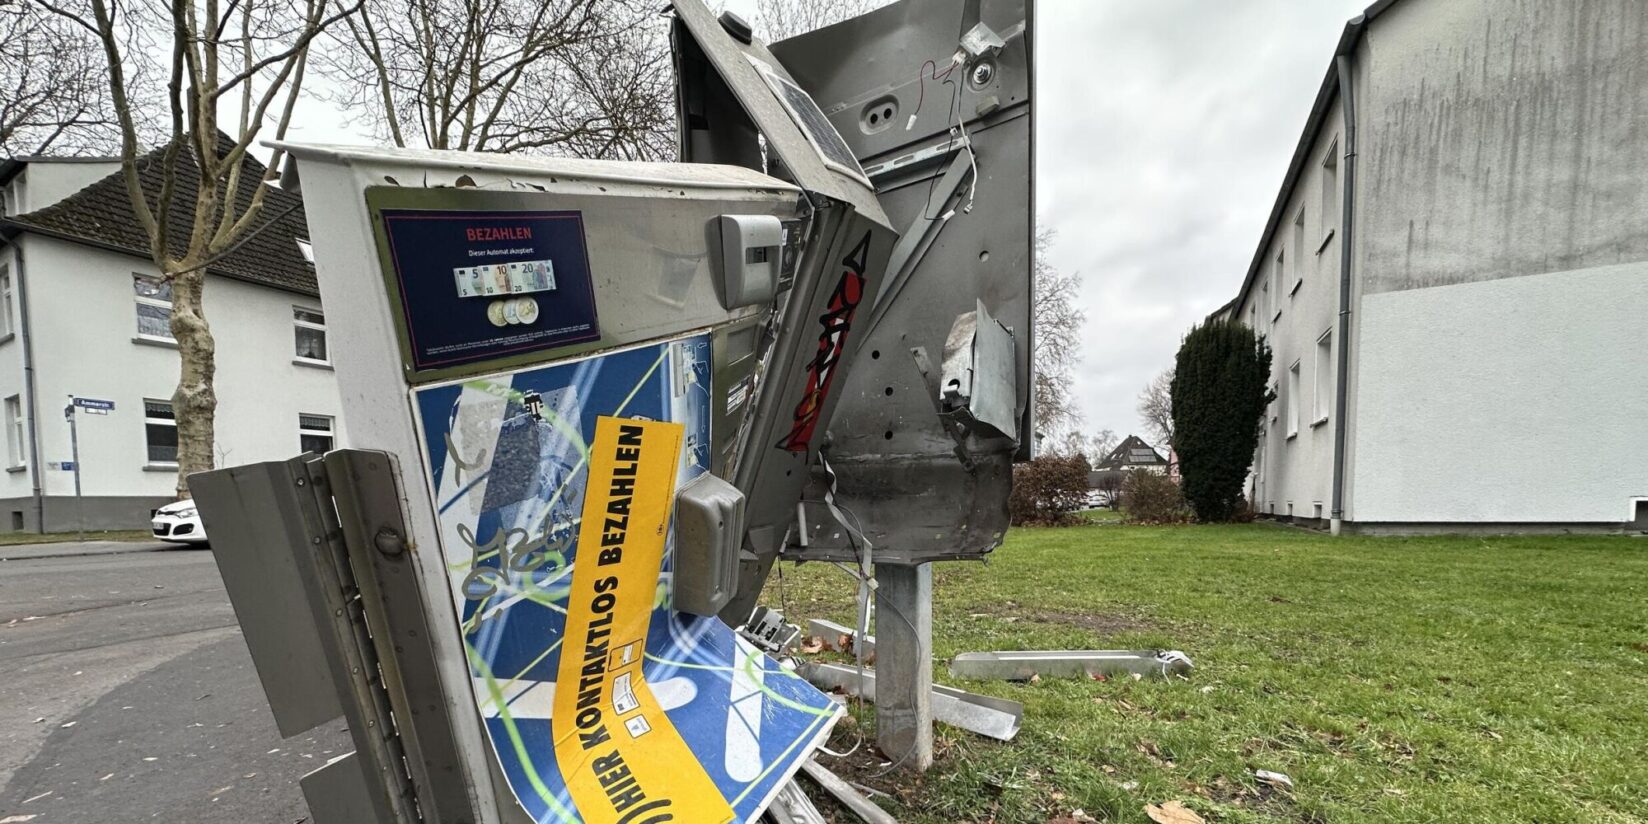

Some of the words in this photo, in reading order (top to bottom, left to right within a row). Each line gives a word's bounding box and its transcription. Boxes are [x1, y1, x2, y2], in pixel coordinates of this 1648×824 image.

[466, 227, 532, 241] BEZAHLEN
[487, 248, 509, 256] Automat
[472, 269, 479, 279] 5
[497, 265, 507, 275] 10
[522, 263, 534, 273] 20
[597, 424, 644, 567] BEZAHLEN
[575, 575, 618, 750] KONTAKTLOS
[591, 749, 647, 813] HIER
